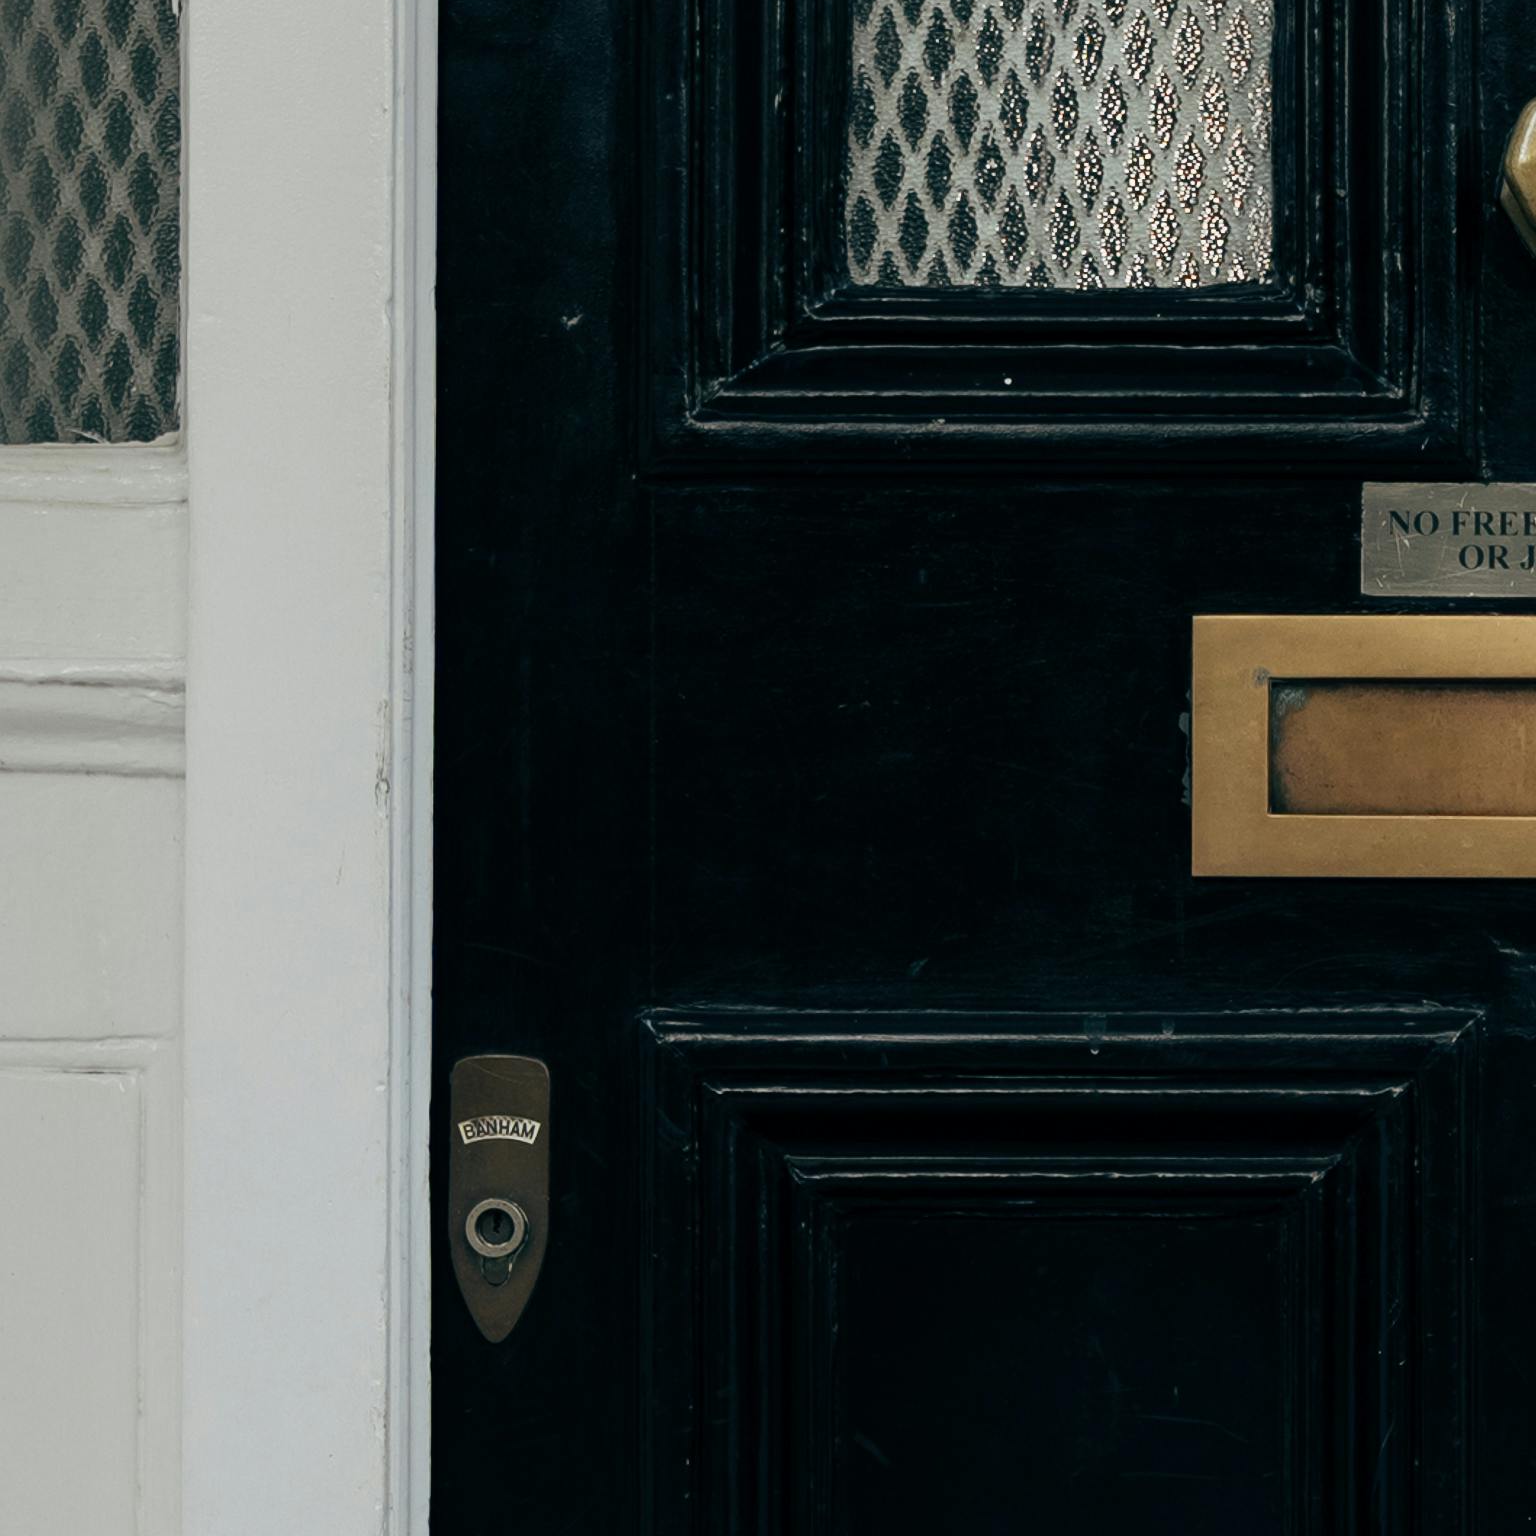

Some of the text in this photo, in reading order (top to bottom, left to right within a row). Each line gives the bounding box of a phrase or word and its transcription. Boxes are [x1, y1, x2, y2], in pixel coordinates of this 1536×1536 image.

[1389, 510, 1440, 537] NO
[1458, 544, 1511, 570] OR
[462, 1118, 536, 1140] BANHAM
